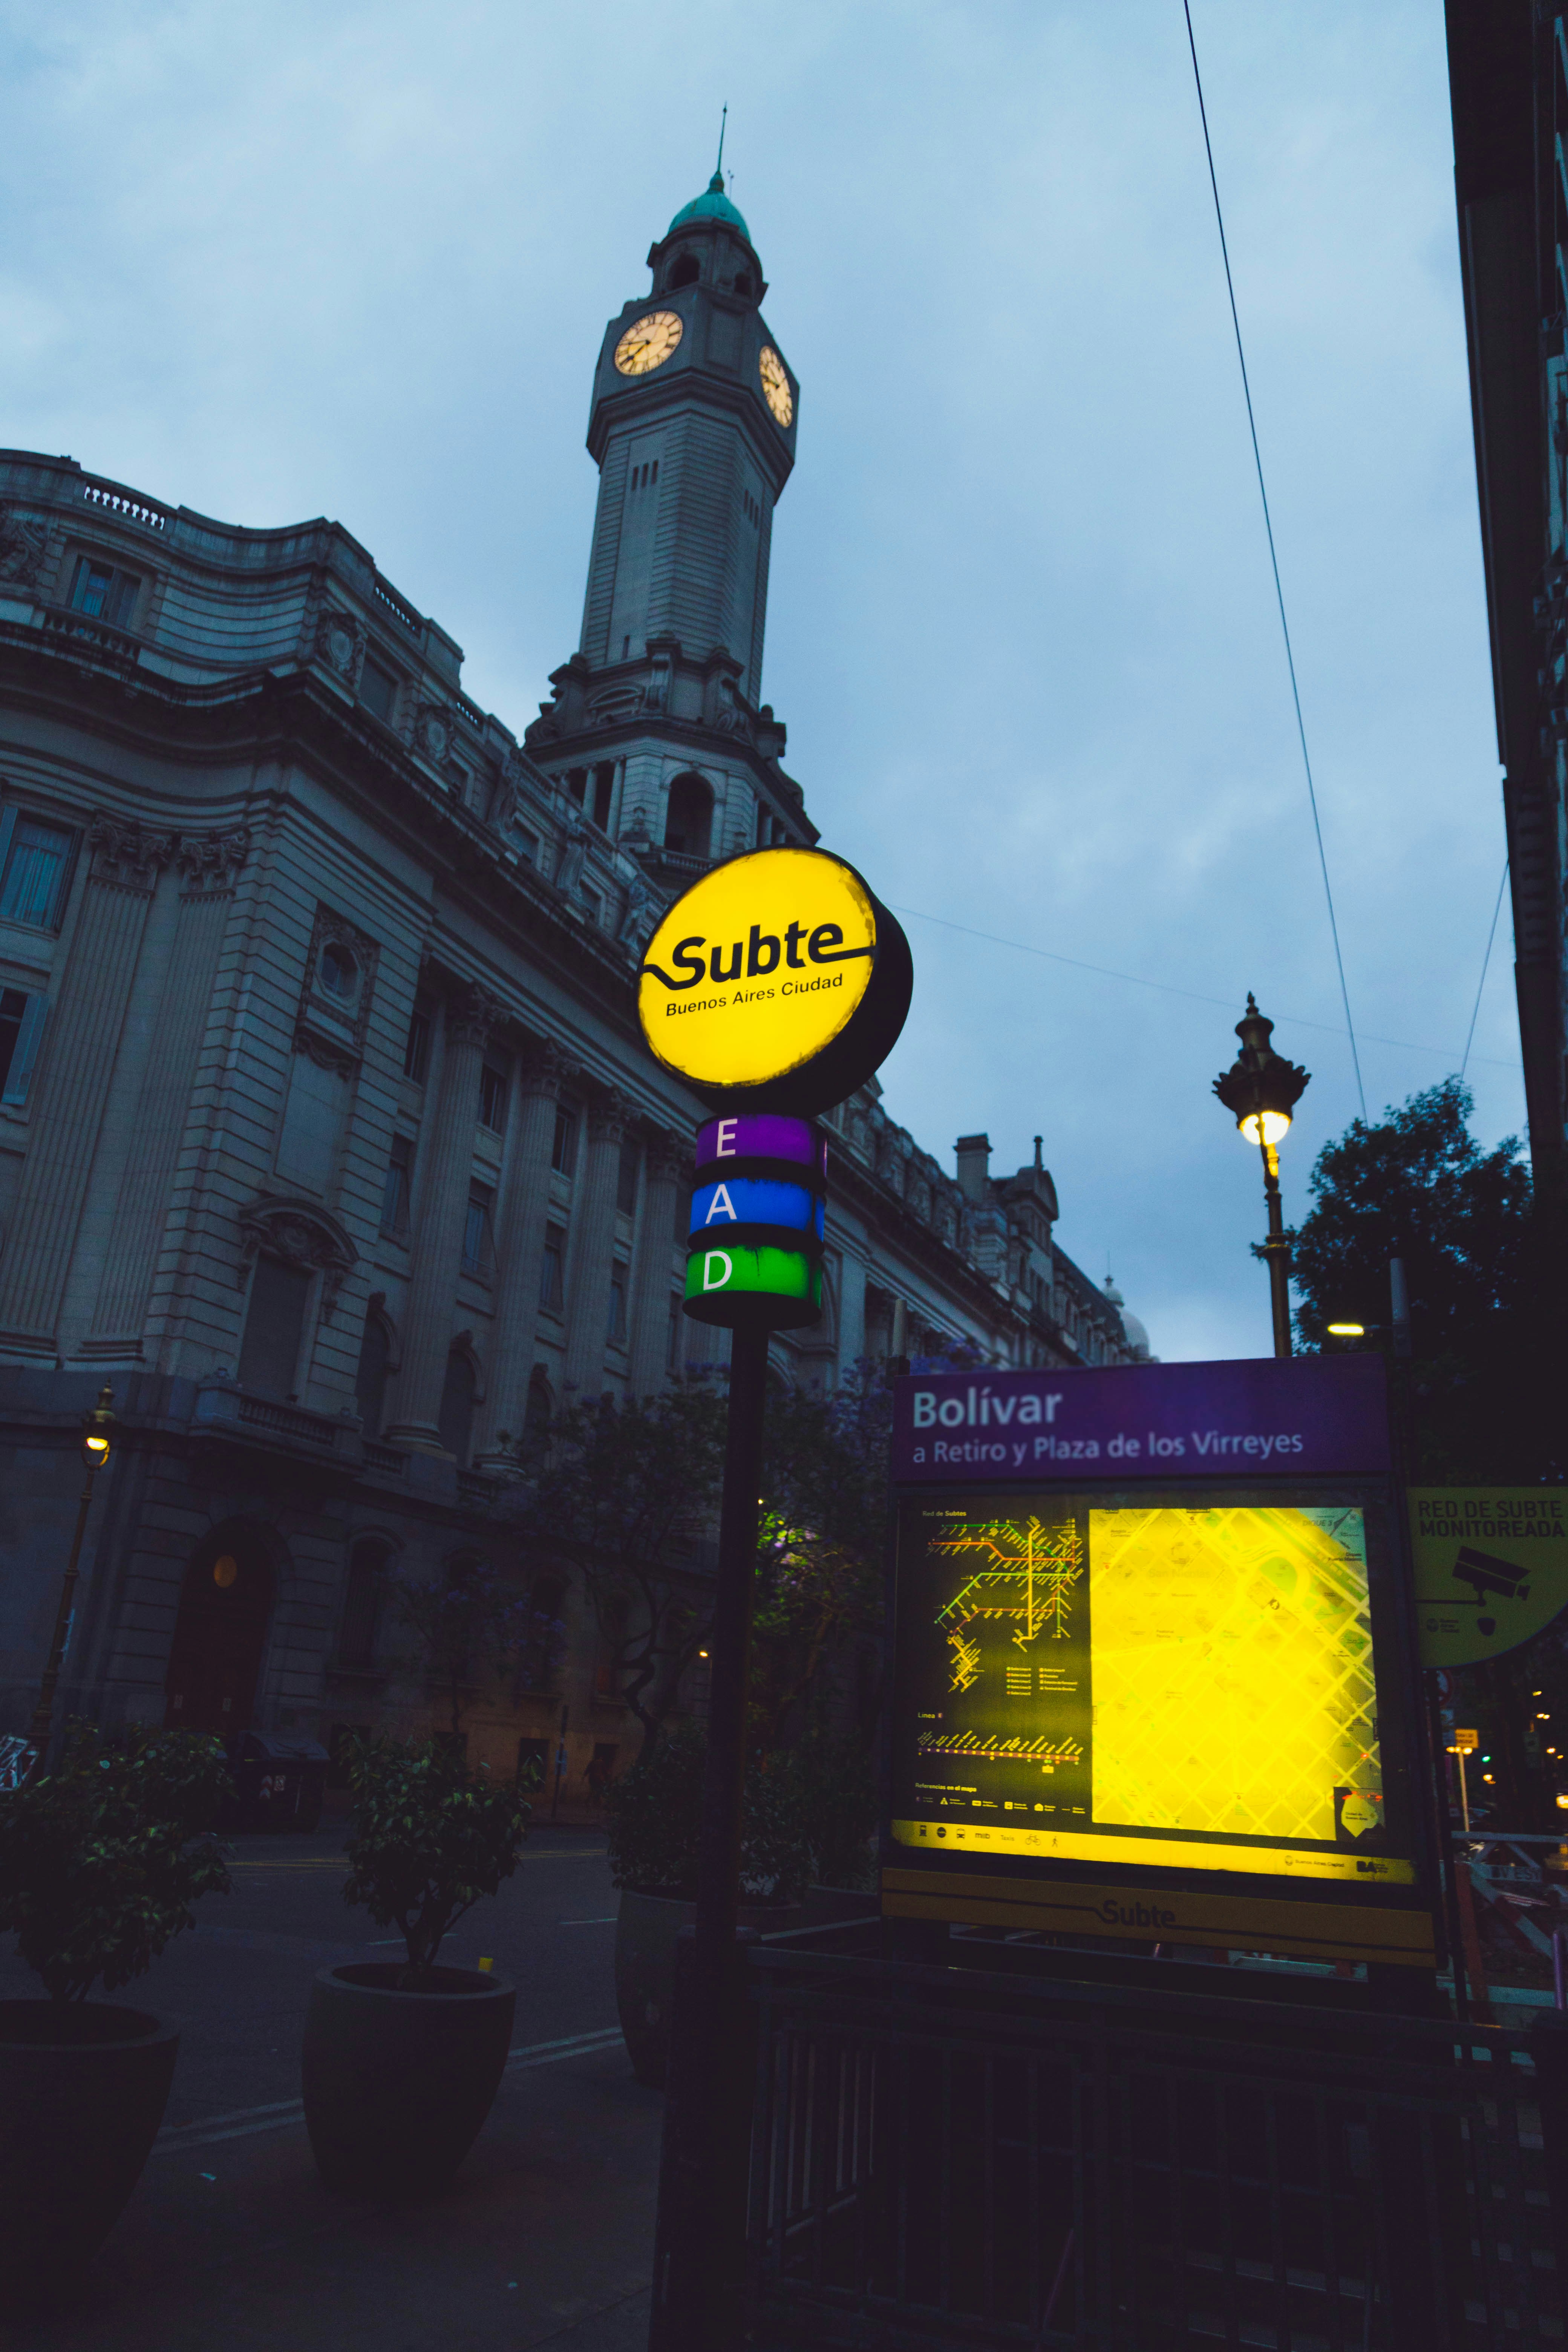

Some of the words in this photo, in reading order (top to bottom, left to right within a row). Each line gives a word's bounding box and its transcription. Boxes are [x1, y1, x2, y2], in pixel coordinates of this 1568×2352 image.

[656, 921, 871, 990] Subte
[666, 994, 727, 1017] Buenos
[732, 988, 775, 1005] Aires
[781, 973, 843, 995] Ciudad
[716, 1119, 738, 1157] E
[705, 1184, 737, 1223] A
[703, 1251, 732, 1291] D
[912, 1386, 1063, 1428] Bolívar
[913, 1447, 926, 1463] a
[934, 1439, 1006, 1462] Retiro
[1012, 1442, 1027, 1467] y
[1035, 1436, 1100, 1460] Plaza
[1107, 1433, 1141, 1458] de
[1148, 1432, 1187, 1456] los
[1192, 1431, 1305, 1460] Virreyes
[1418, 1501, 1458, 1518] RED
[1465, 1501, 1491, 1518] DE
[1496, 1500, 1563, 1518] SUBTE
[1419, 1520, 1566, 1537] MONITOREADA
[1102, 1900, 1176, 1929] Subte
